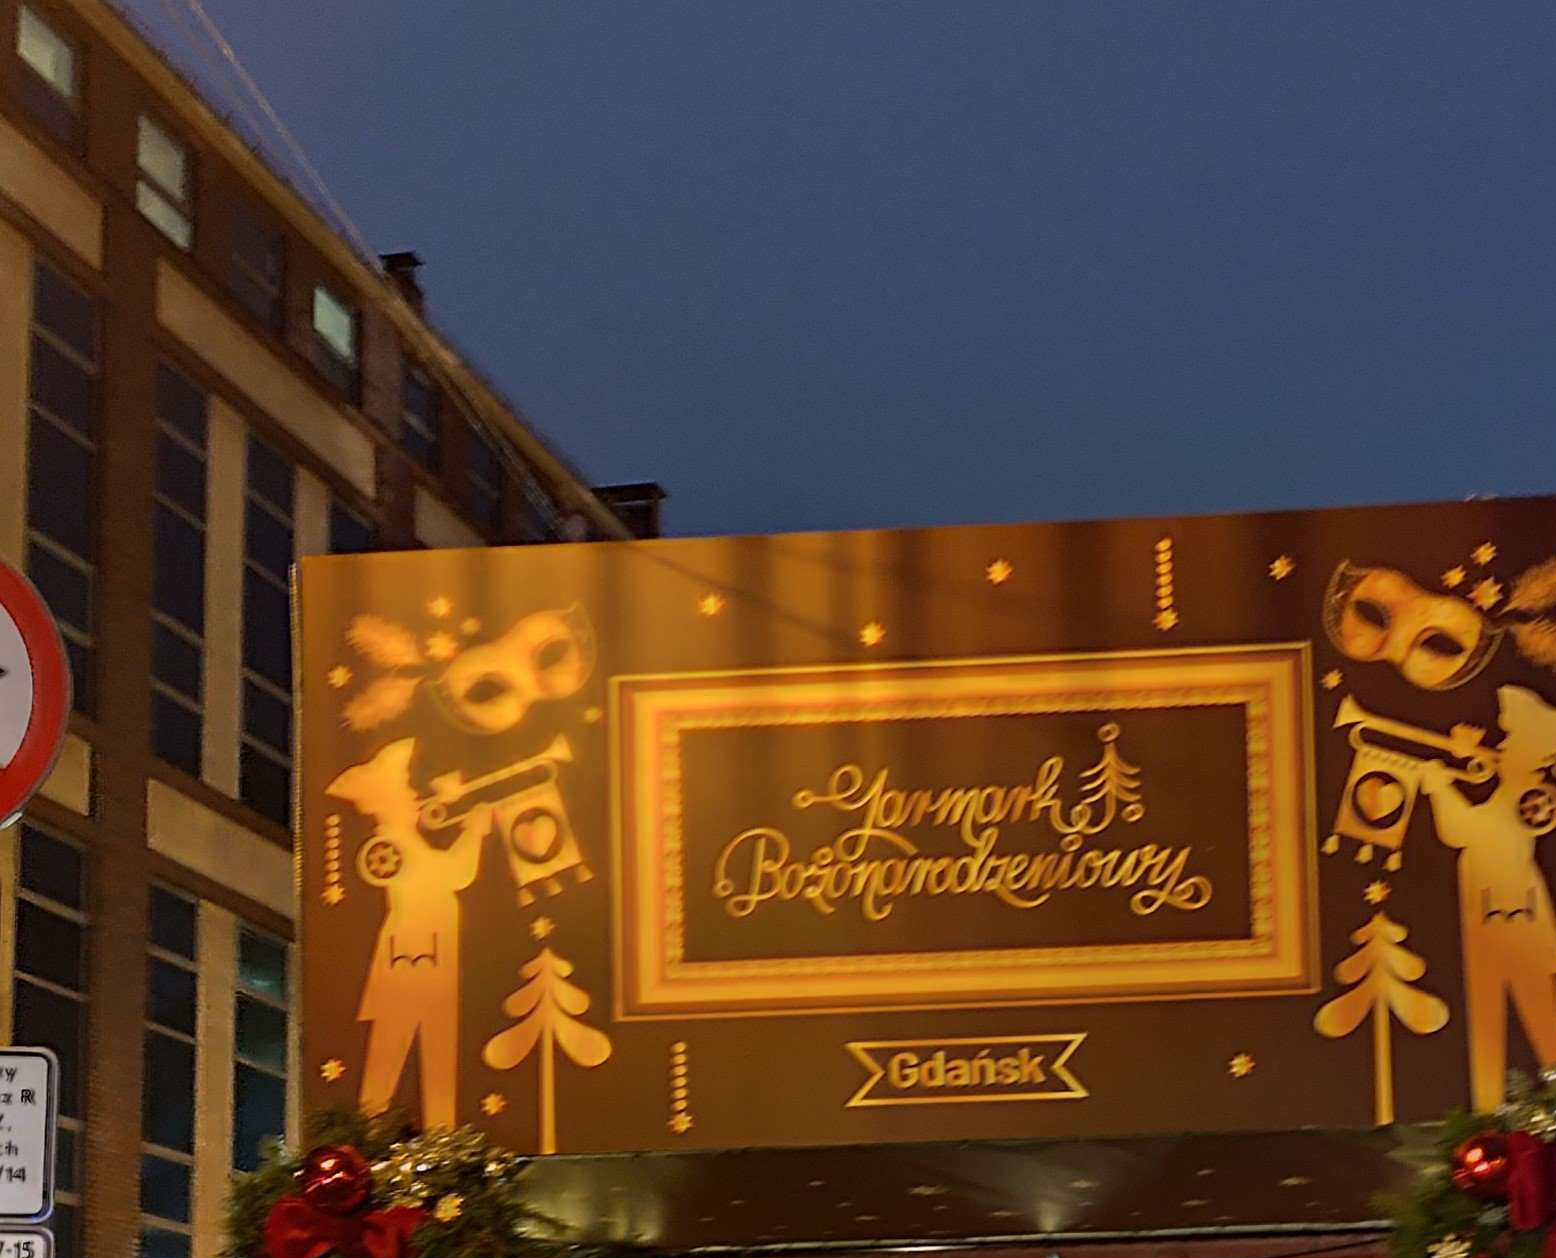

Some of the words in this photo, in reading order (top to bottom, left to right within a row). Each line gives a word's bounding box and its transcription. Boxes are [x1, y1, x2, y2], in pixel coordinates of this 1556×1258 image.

[793, 755, 1103, 862] Jarmark
[712, 827, 1216, 922] Bożonarodzeniowy
[888, 1047, 1048, 1090] Gdańsk
